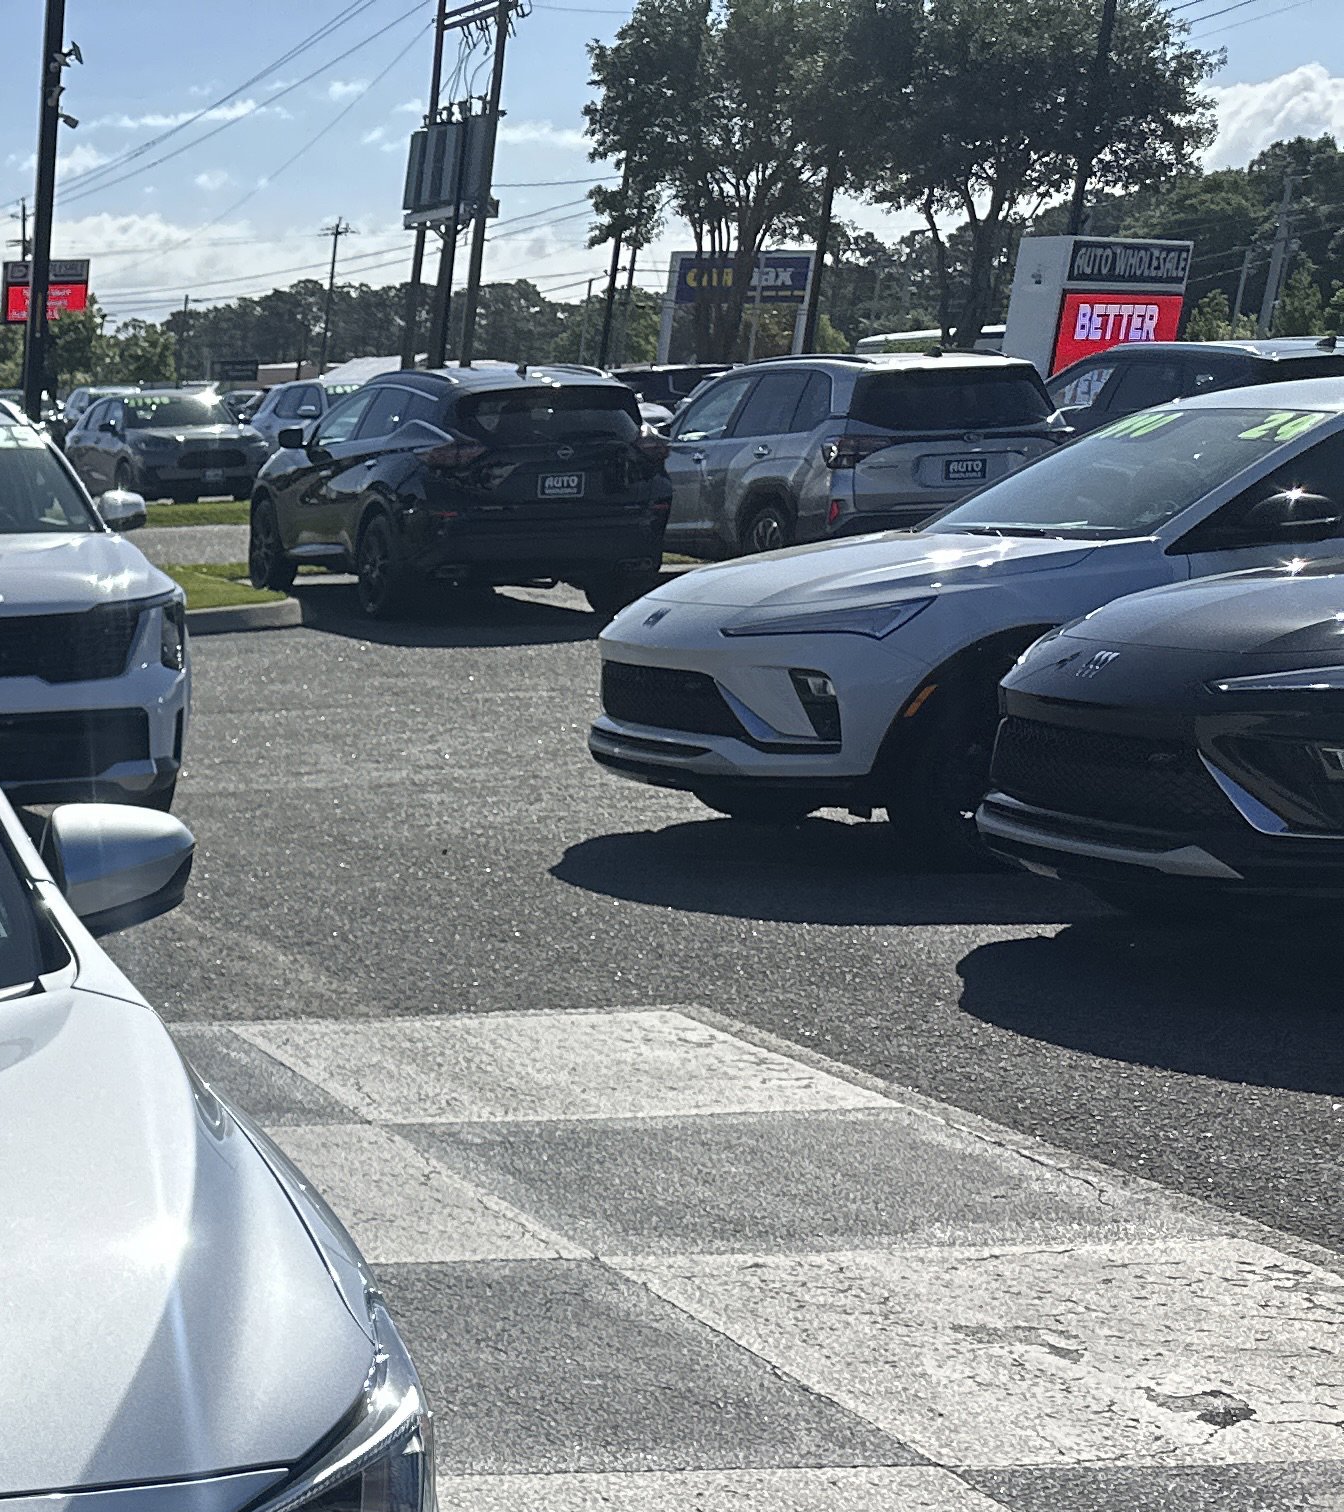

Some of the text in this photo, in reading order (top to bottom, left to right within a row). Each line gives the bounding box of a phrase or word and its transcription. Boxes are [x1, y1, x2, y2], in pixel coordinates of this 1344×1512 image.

[1074, 248, 1188, 279] AUTO WHOLESALE
[1074, 303, 1159, 340] BETTER
[949, 460, 982, 472] AUTO
[544, 475, 578, 488] AUTO
